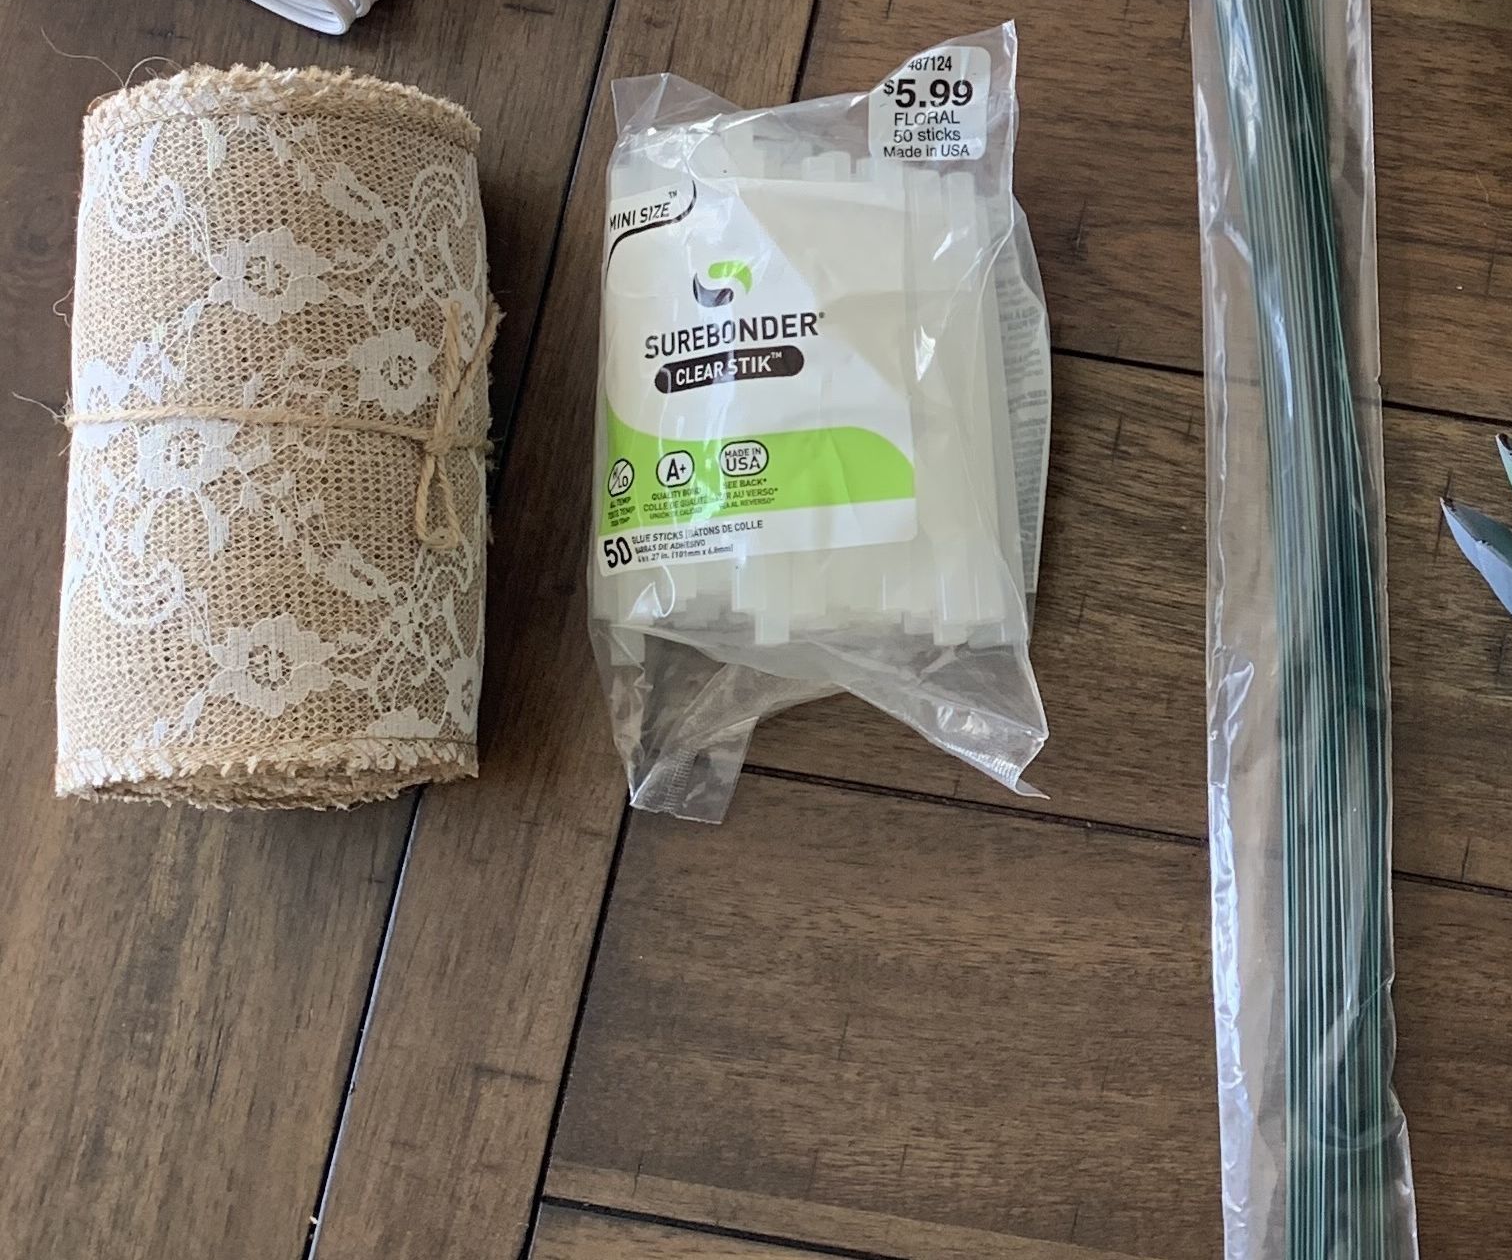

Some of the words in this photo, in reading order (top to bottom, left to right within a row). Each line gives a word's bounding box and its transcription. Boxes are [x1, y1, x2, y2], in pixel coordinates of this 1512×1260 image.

[883, 79, 973, 109] $5.99
[894, 110, 961, 126] FLORAL
[893, 129, 913, 144] 50
[917, 127, 961, 142] sticks
[883, 146, 922, 158] Made
[926, 144, 937, 157] in
[941, 144, 970, 157] USA
[609, 209, 636, 233] MINI
[675, 362, 724, 386] CLEAR
[724, 447, 750, 458] MADE
[752, 447, 762, 455] IN
[666, 458, 688, 482] A+
[726, 456, 761, 471] USA
[643, 502, 668, 512] COLLE
[603, 536, 633, 569] 50
[652, 530, 683, 542] STICKS
[721, 524, 734, 534] DE
[734, 519, 764, 531] COLLE
[658, 541, 669, 551] DE
